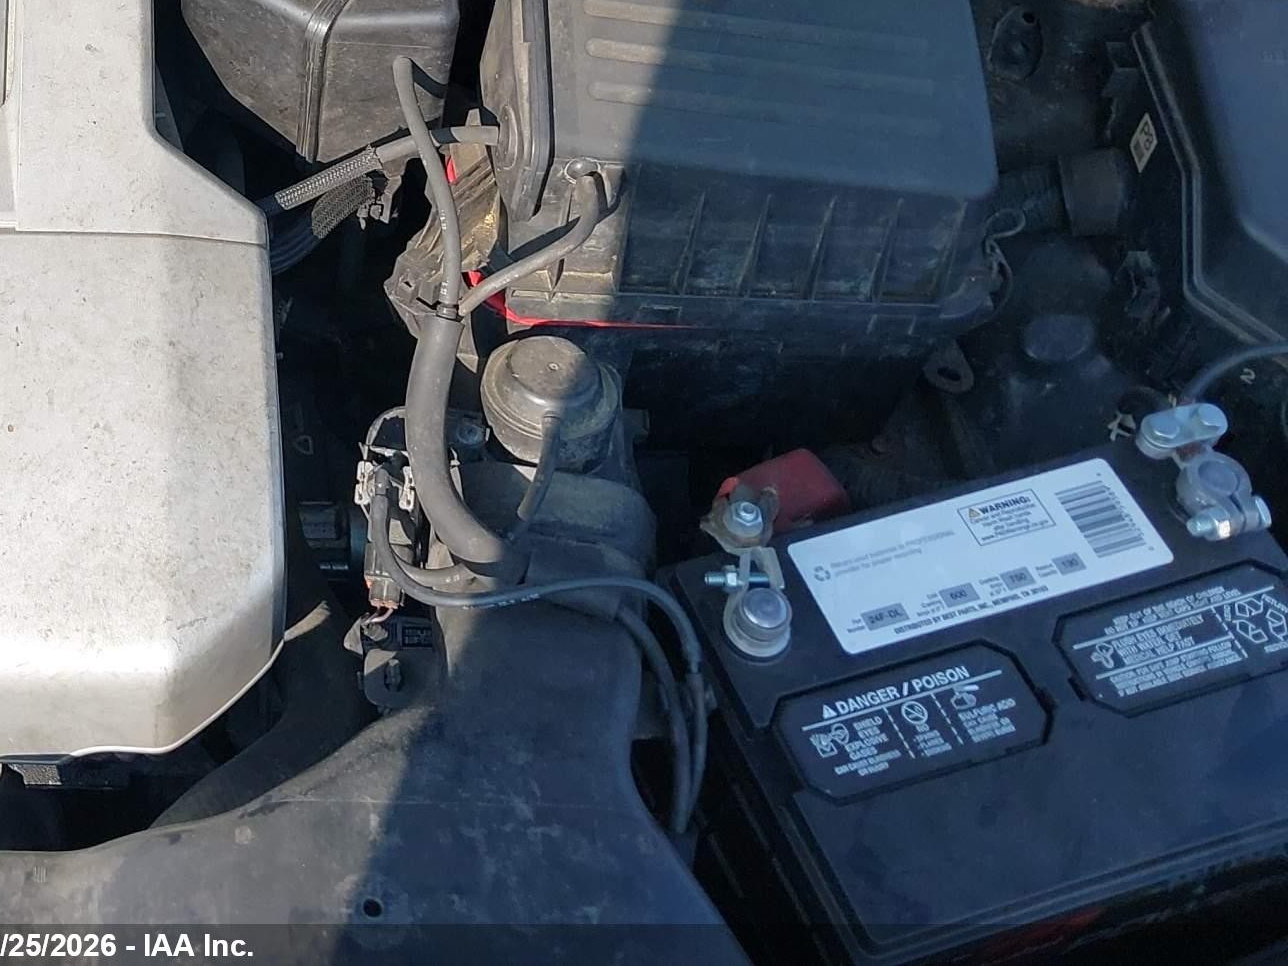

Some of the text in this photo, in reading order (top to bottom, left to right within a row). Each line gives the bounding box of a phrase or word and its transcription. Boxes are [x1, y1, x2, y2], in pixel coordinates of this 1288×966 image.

[979, 496, 1031, 514] WARNING:
[836, 687, 900, 714] DANGER
[912, 666, 969, 692] POISON
[916, 722, 930, 732] NO
[844, 734, 888, 752] EXPLOSIVE
